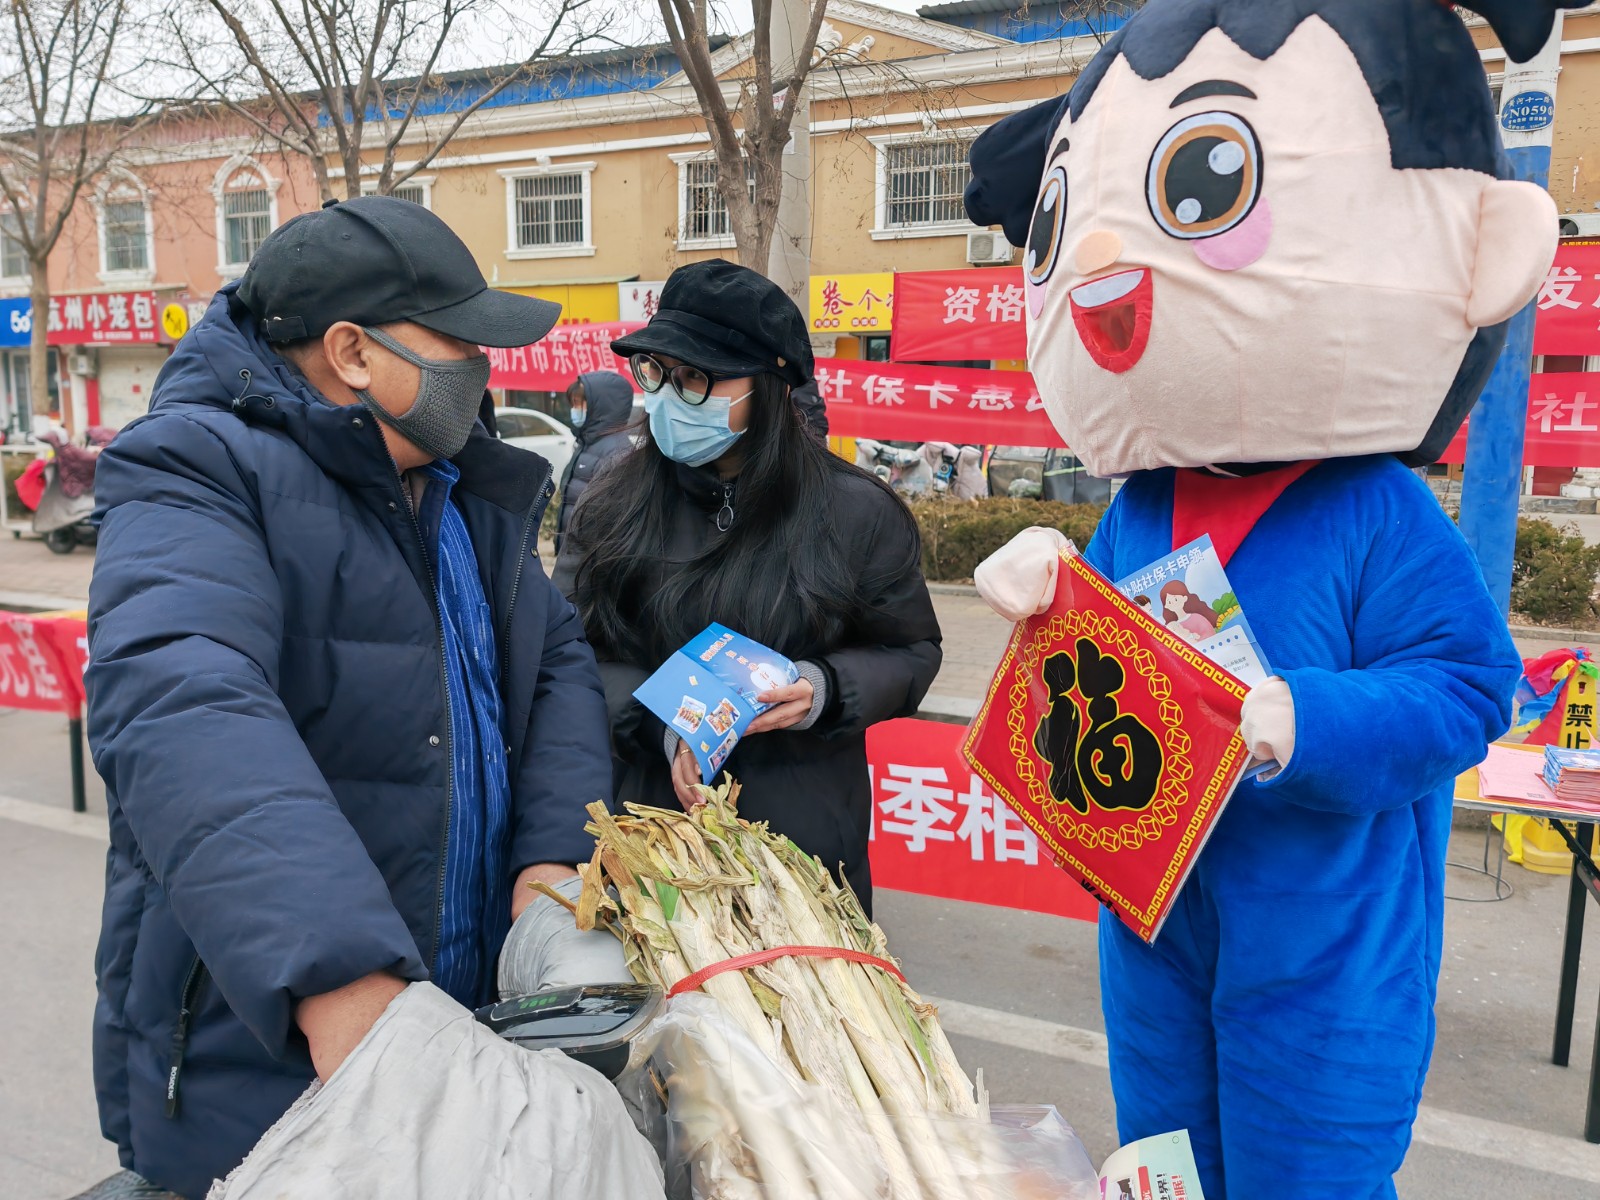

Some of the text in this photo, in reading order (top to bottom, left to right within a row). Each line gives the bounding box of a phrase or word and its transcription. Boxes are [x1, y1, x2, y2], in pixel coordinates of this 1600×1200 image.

[942, 283, 1025, 324] 资格
[1537, 266, 1600, 311] 发
[815, 367, 1045, 412] 社保卡惠
[1531, 391, 1599, 433] 社
[1032, 637, 1164, 816] 福
[868, 763, 1065, 868] 季相
